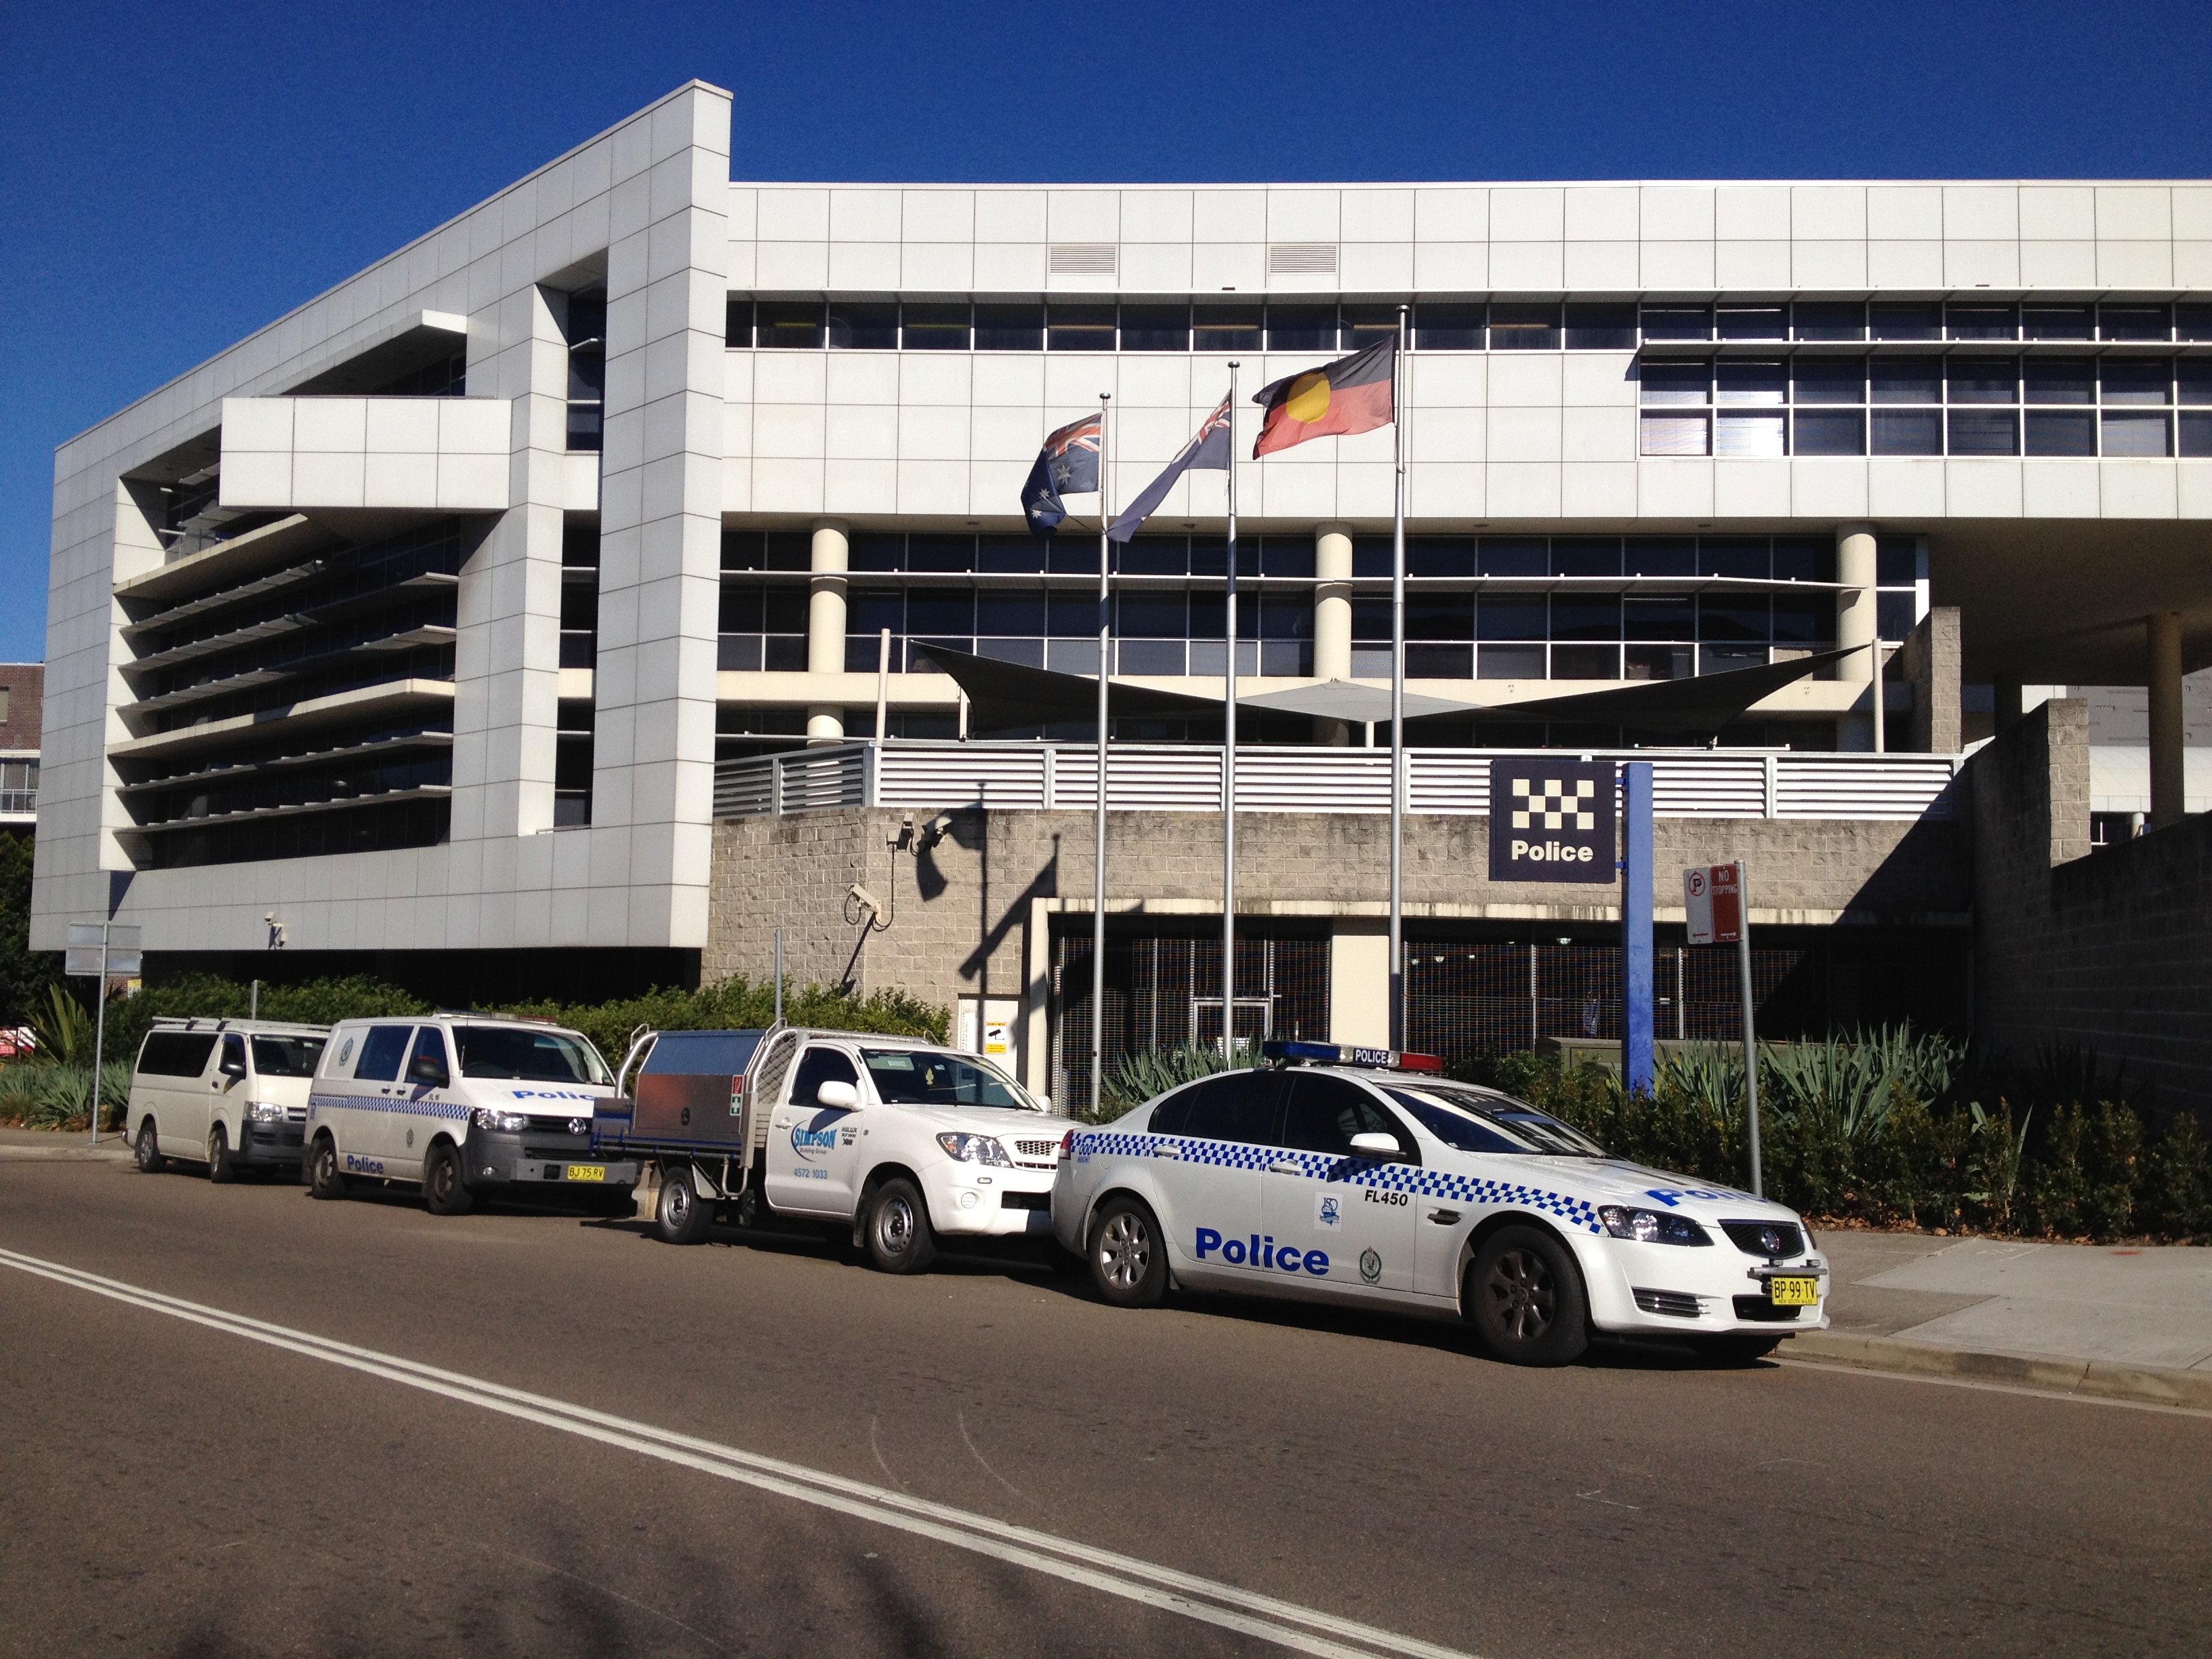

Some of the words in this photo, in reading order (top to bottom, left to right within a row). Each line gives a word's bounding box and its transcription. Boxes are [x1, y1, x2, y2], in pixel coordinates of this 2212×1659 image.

[1511, 840, 1594, 862] Police
[1718, 869, 1729, 882] NO
[1712, 884, 1738, 895] STOPPING
[1355, 1048, 1387, 1065] POLICE
[512, 1090, 595, 1101] Polic
[794, 1126, 838, 1150] SIMPSON
[1079, 1143, 1093, 1155] 000
[347, 1154, 384, 1174] Police
[569, 1167, 580, 1176] BJ
[582, 1168, 592, 1177] 75
[594, 1168, 604, 1178] RV
[794, 1168, 810, 1178] 4572
[813, 1169, 827, 1179] 1033
[1364, 1189, 1409, 1206] FL450
[1195, 1227, 1329, 1275] Police
[1774, 1280, 1786, 1298] BP
[1789, 1280, 1801, 1298] 99
[1804, 1280, 1815, 1298] TV
